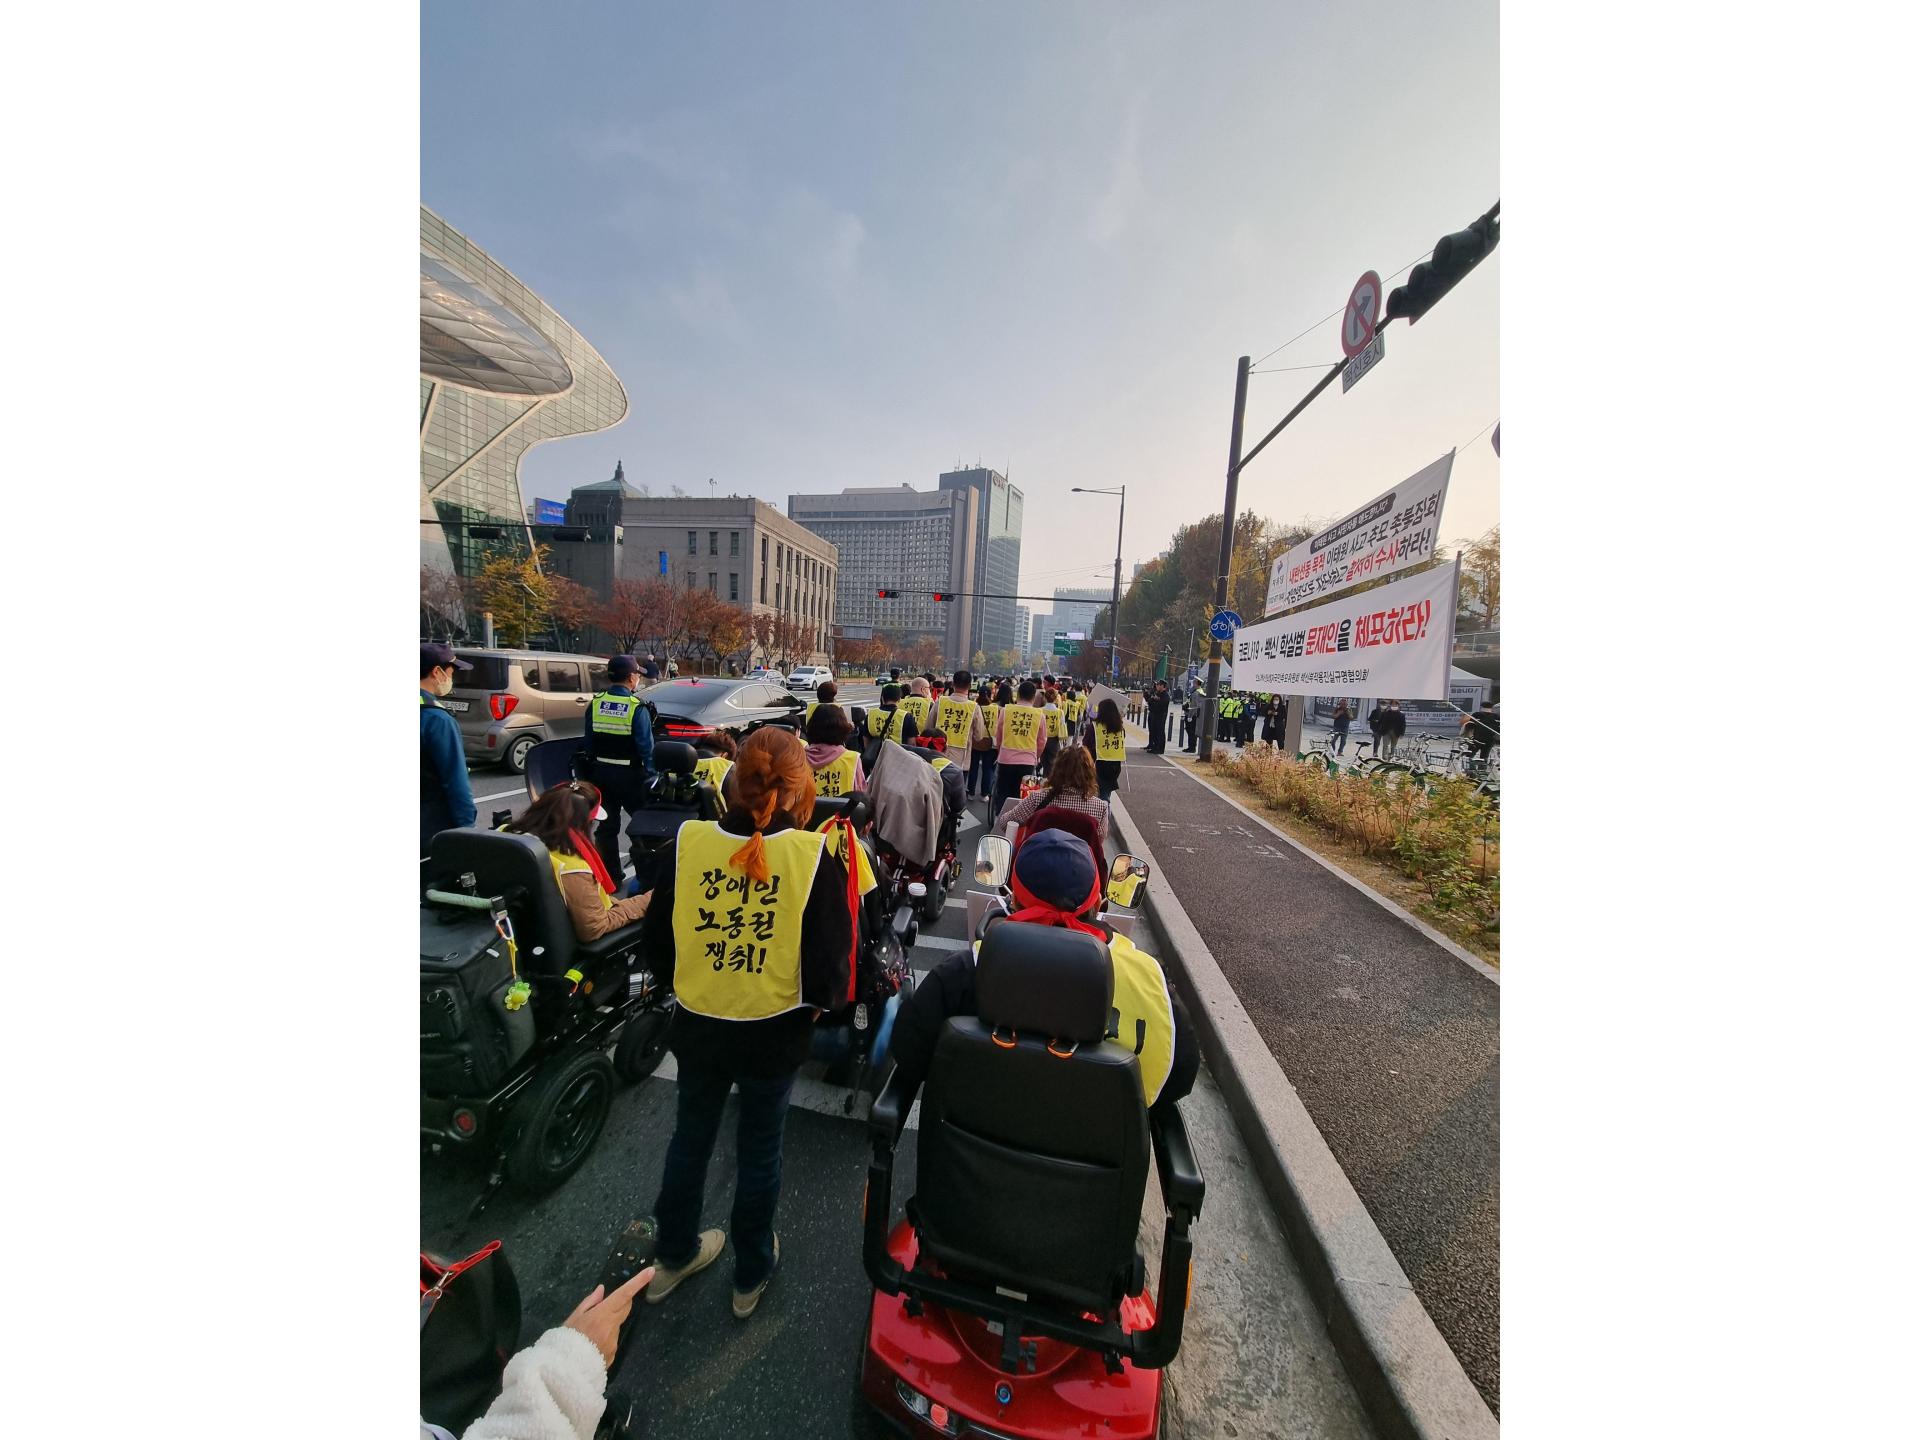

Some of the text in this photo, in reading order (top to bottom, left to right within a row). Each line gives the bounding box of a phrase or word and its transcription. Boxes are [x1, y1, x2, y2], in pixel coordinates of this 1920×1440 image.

[1327, 540, 1349, 566] 이태원
[1349, 532, 1368, 555] 사고
[1367, 520, 1389, 547] 추모
[1390, 489, 1441, 537] 촛불집회
[1375, 527, 1431, 570] 수사하라!
[1264, 635, 1280, 660] 백신
[1280, 630, 1306, 658] 학살범
[1305, 619, 1352, 656] 문재인을
[1355, 600, 1430, 648] 체포하라!
[941, 719, 966, 734] 투쟁!
[944, 708, 969, 722] 단결!
[699, 868, 781, 905] 장애인
[694, 907, 776, 942] 노동권
[704, 940, 768, 975] 쟁취!
